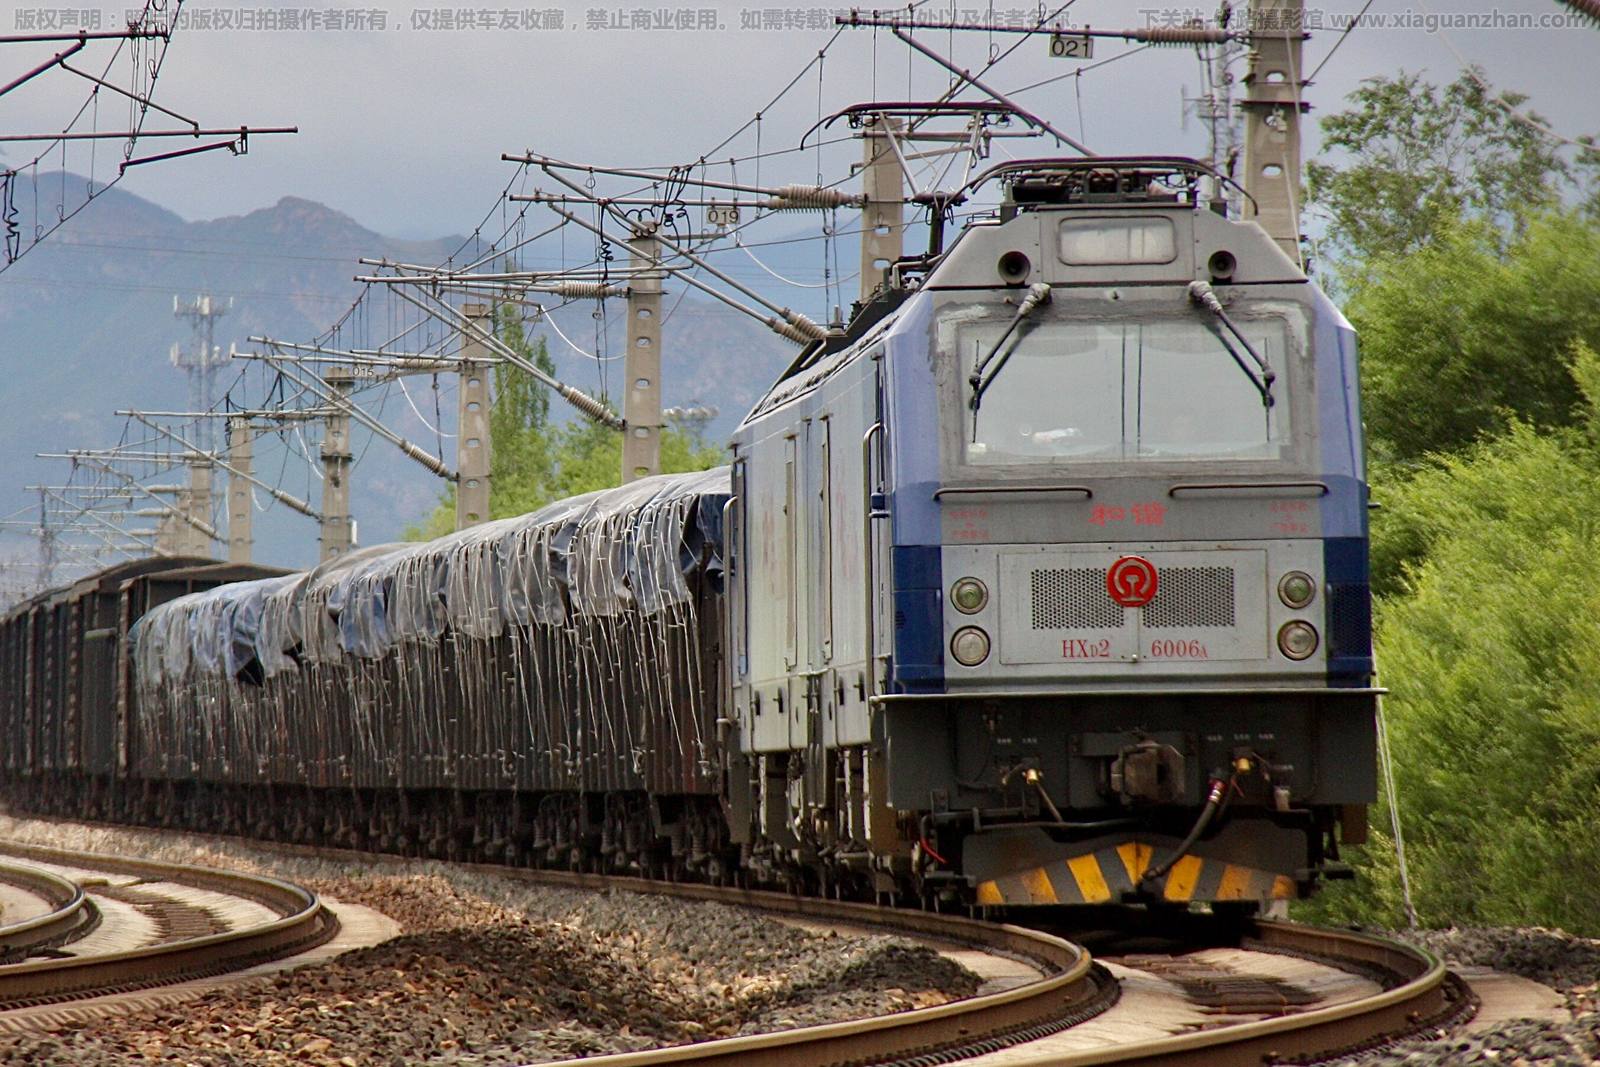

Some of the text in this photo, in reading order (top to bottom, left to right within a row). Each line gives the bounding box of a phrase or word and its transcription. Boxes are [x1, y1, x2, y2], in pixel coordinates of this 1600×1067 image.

[1052, 39, 1089, 58] 021
[708, 210, 739, 224] 019
[352, 366, 374, 377] 015
[1088, 501, 1167, 527] 和谐
[1151, 639, 1208, 659] 6006A
